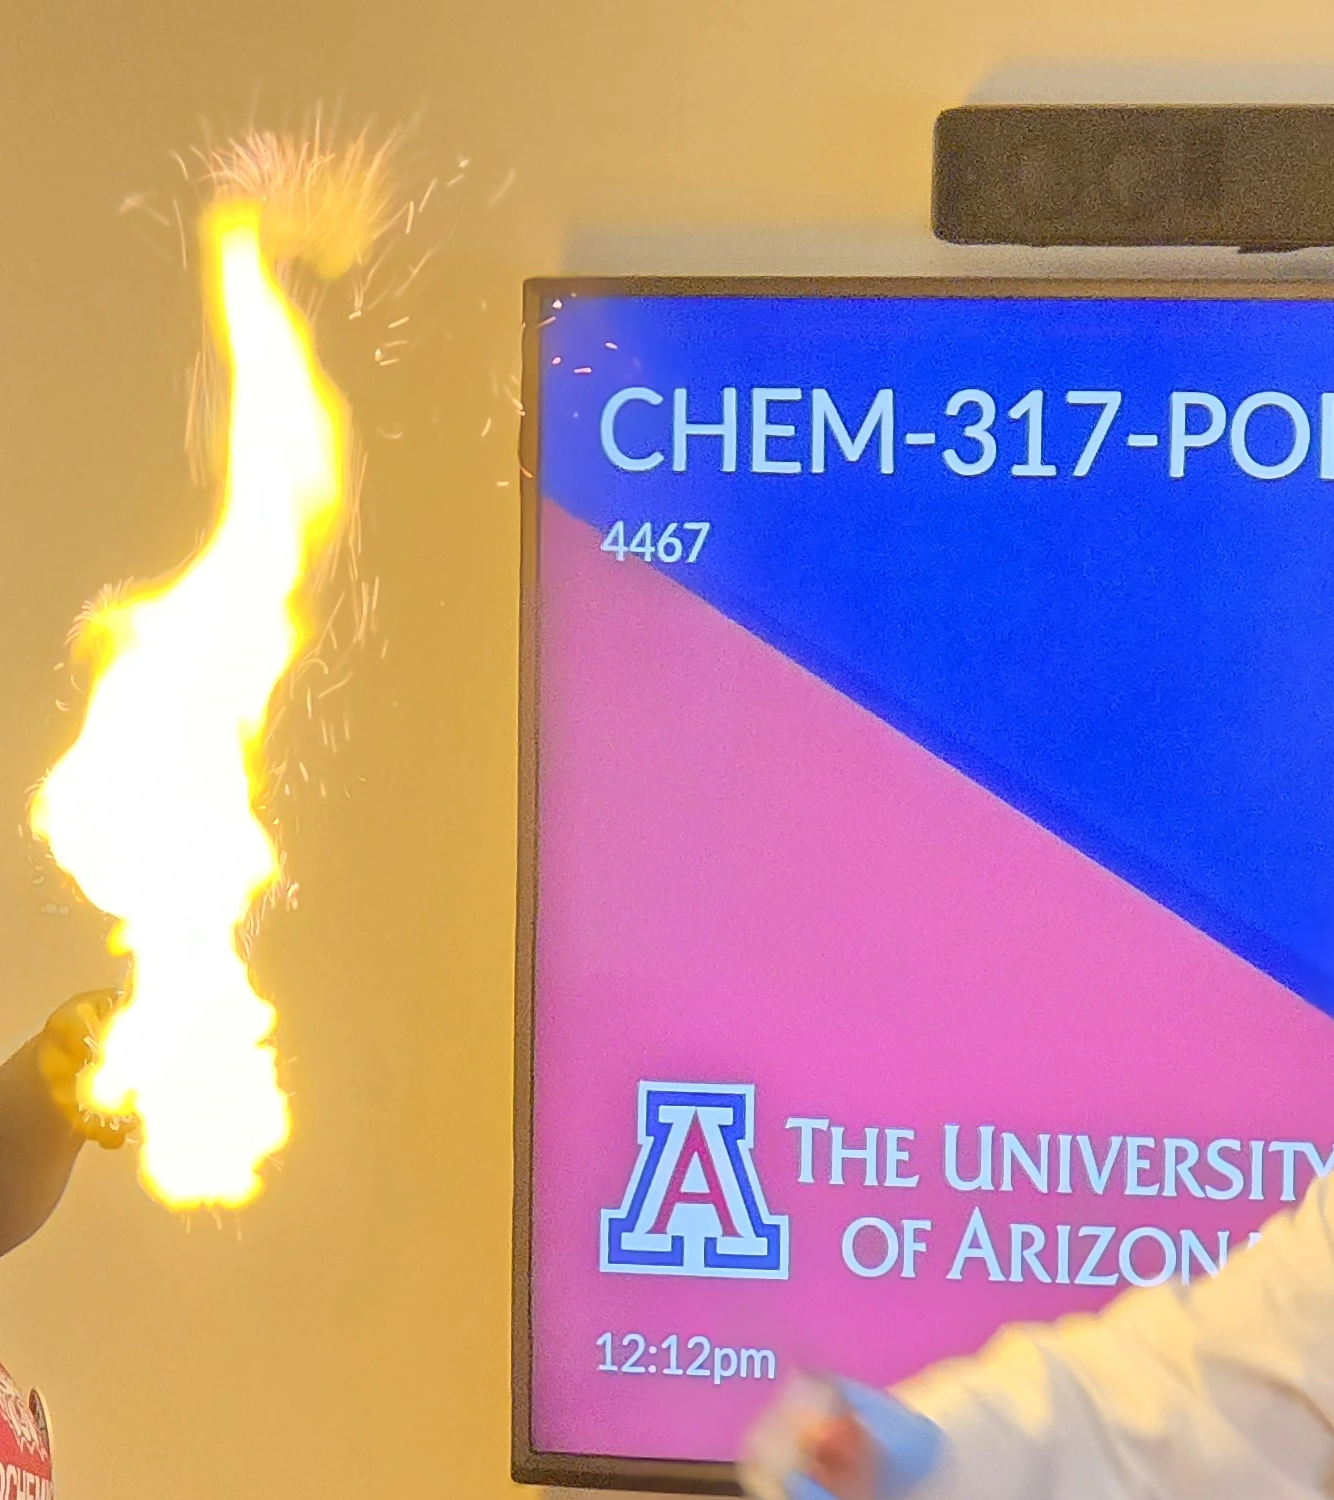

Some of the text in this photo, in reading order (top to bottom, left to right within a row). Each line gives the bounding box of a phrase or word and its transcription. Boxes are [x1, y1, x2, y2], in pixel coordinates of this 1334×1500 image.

[601, 522, 709, 563] 4467
[785, 1116, 919, 1189] THE
[841, 1207, 1262, 1288] OF ARIZON
[596, 1332, 776, 1384] 12:12pm
